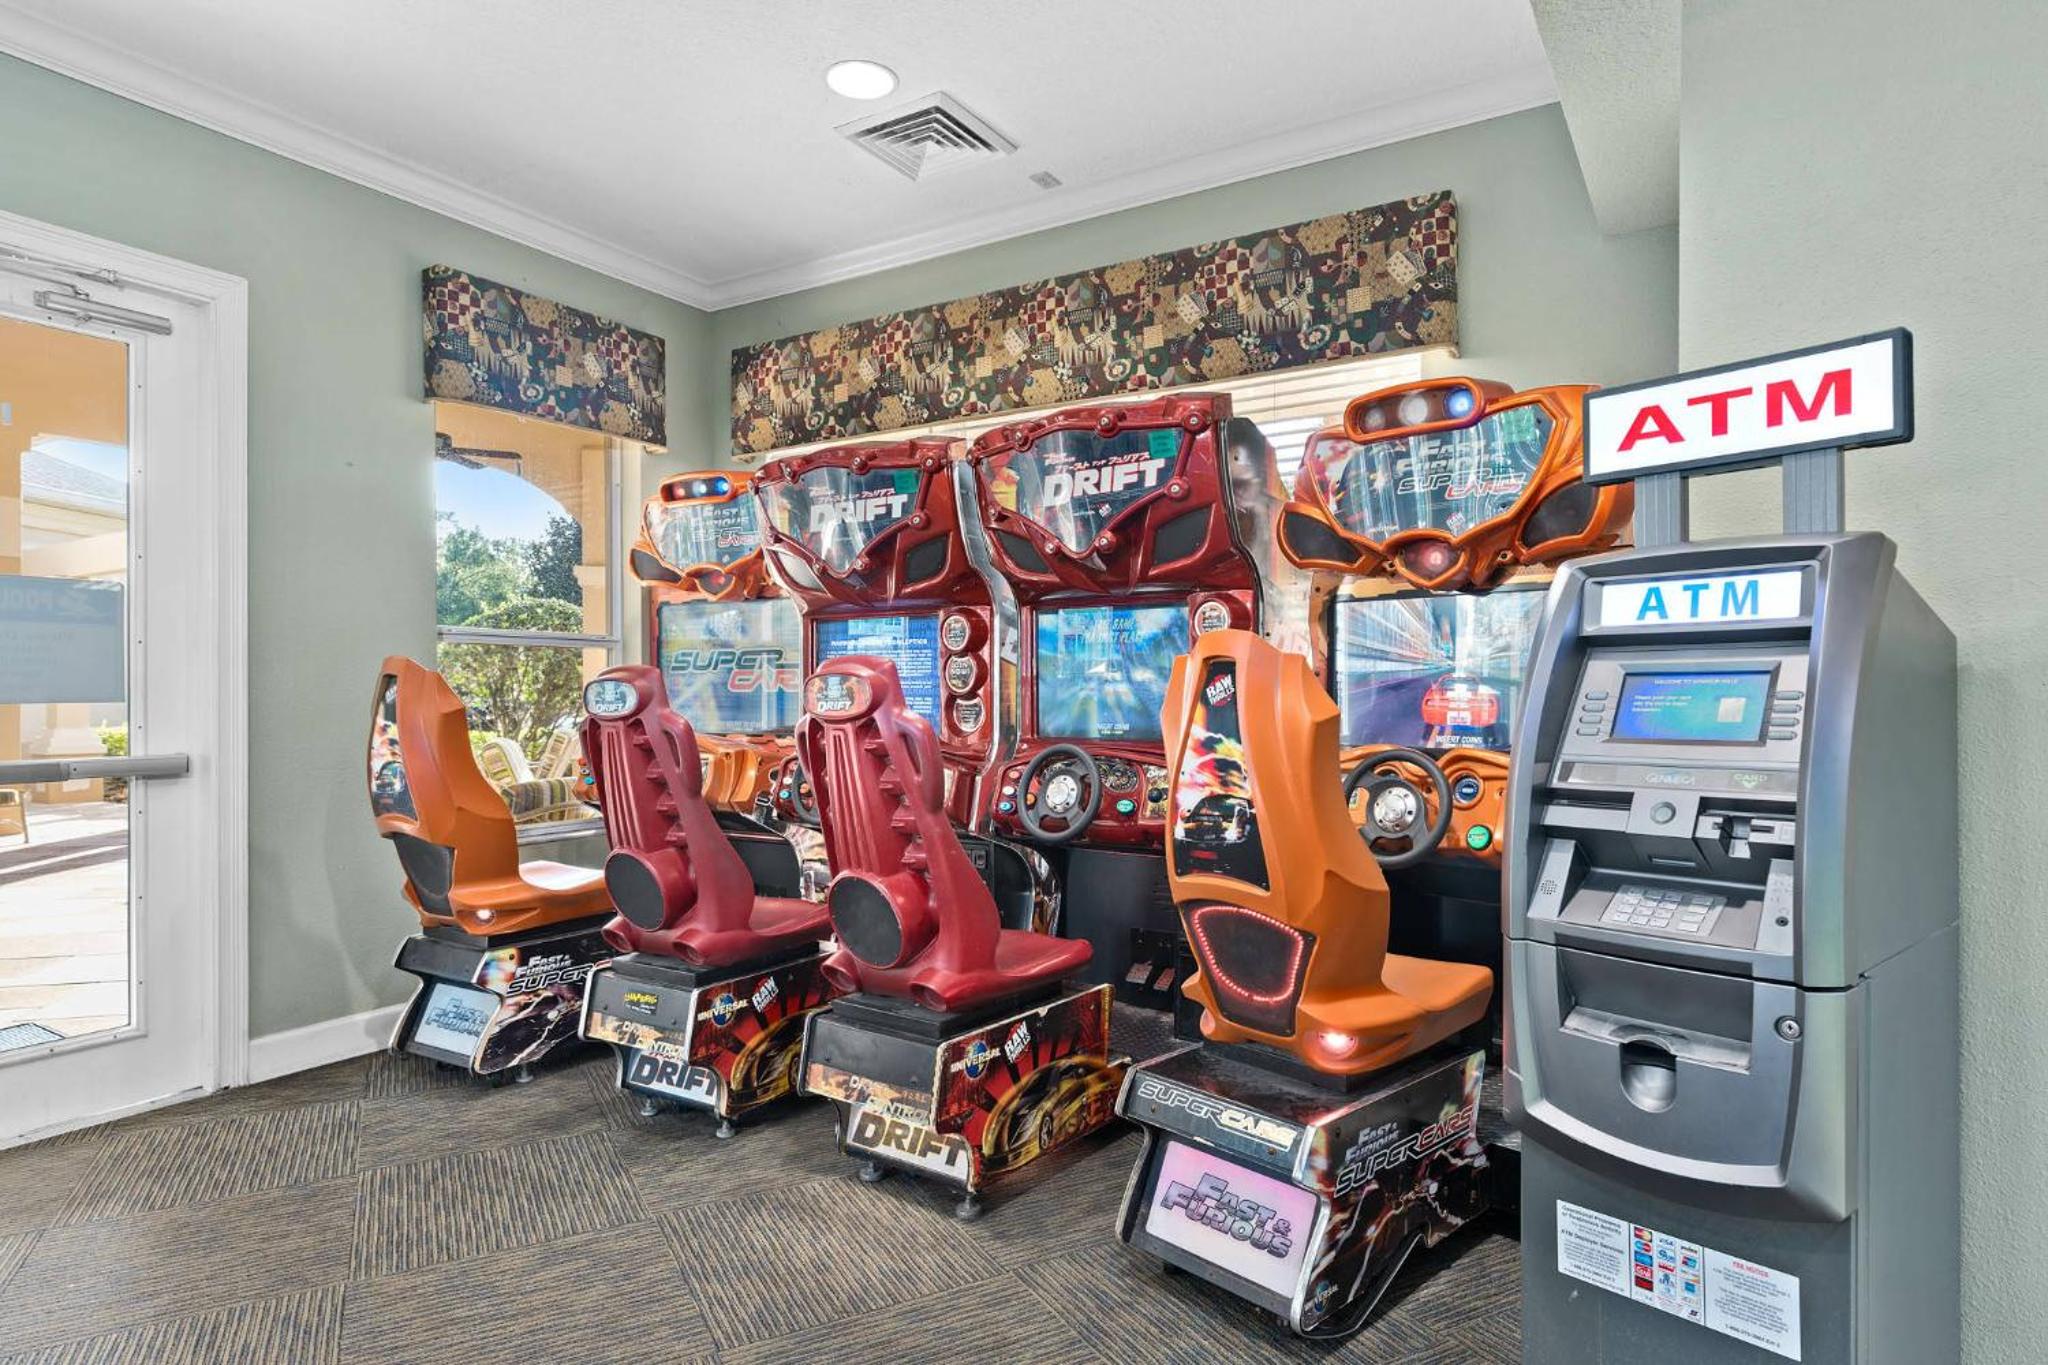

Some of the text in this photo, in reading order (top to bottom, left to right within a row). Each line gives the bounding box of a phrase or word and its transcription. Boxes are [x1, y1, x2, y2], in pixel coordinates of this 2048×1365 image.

[1616, 367, 1853, 453] ATM
[1043, 459, 1165, 507] DRIFT
[809, 494, 909, 534] DRIFT
[1636, 579, 1760, 621] ATM
[670, 648, 784, 673] SUPER
[817, 701, 852, 713] DRIFT
[1206, 674, 1232, 698] RAW
[630, 1054, 717, 1096] DRIFT
[851, 1110, 965, 1168] DRIFT
[1161, 1181, 1292, 1257] FURIOUS
[1197, 1172, 1277, 1232] FAST
